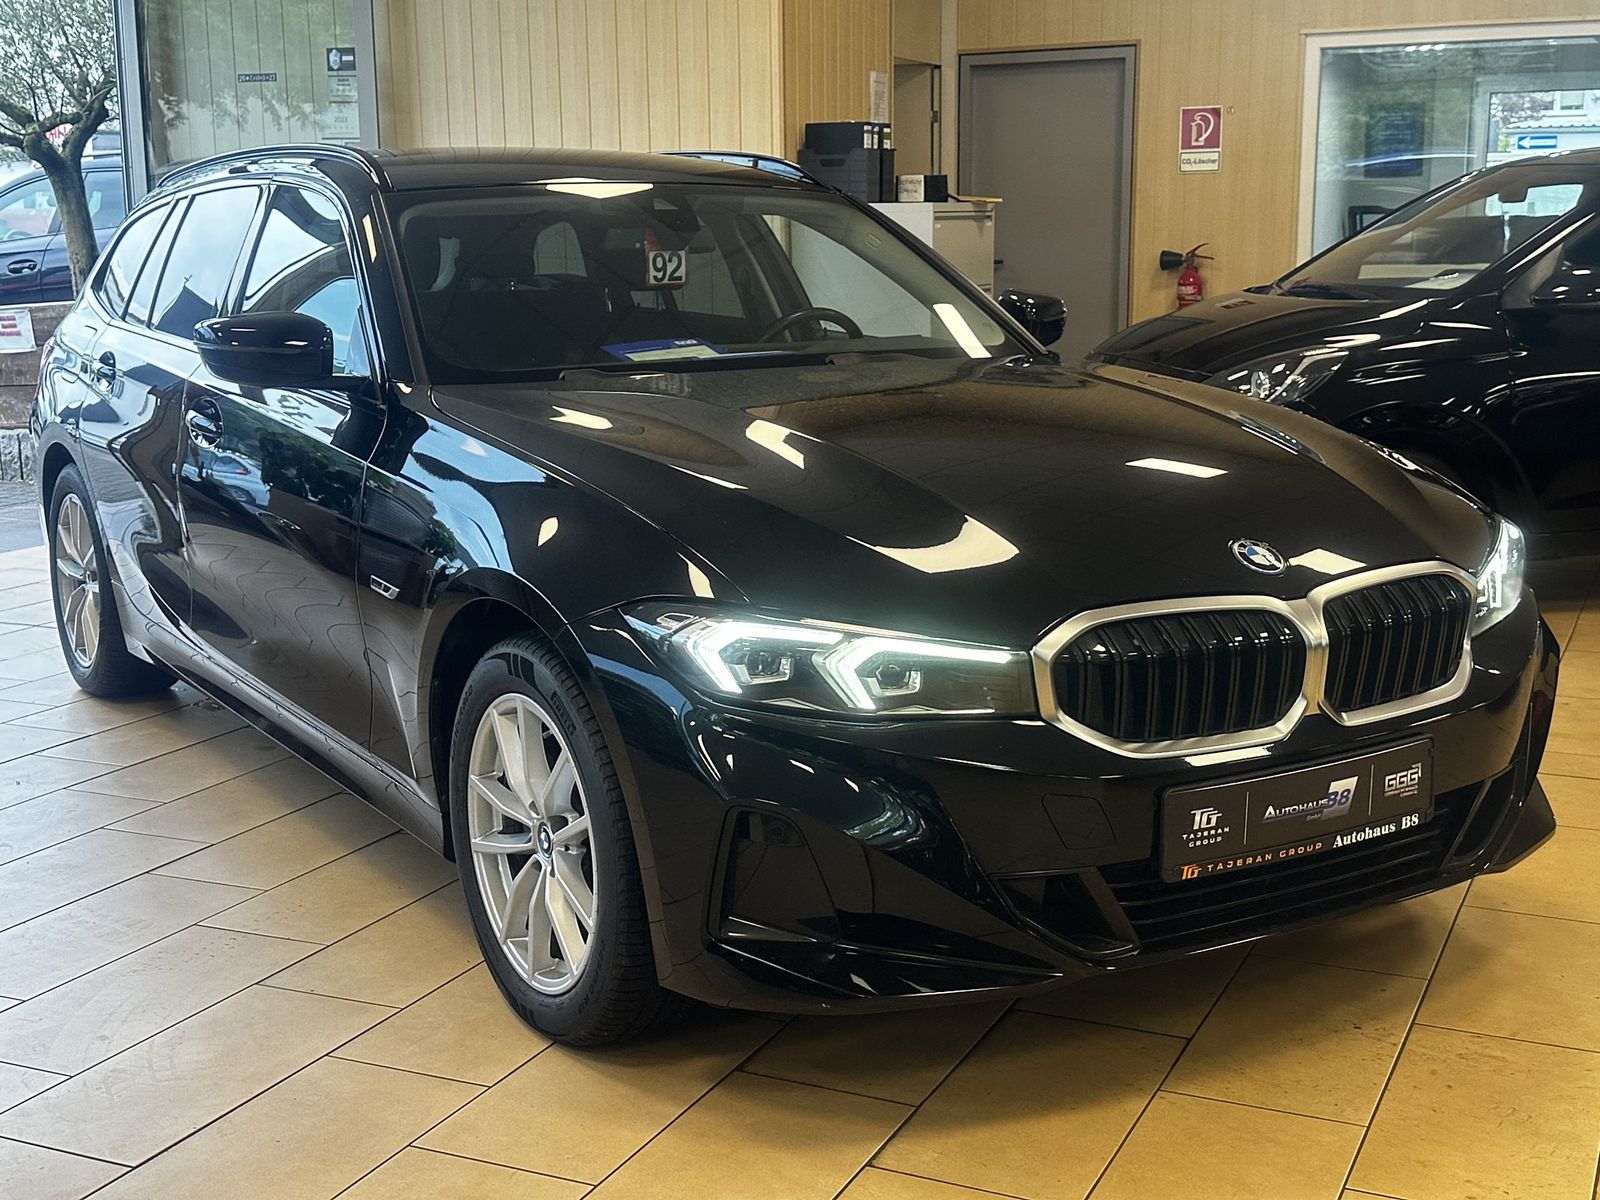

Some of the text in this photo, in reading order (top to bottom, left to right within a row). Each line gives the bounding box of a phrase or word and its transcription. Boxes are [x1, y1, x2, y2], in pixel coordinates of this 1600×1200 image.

[651, 252, 683, 282] 92
[1326, 788, 1351, 809] B8
[1181, 826, 1230, 840] TAJERAN
[1188, 836, 1222, 848] GROUP
[1207, 852, 1273, 872] TAJERAN
[1279, 842, 1323, 858] GROUP
[1332, 822, 1396, 848] Autohaus
[1401, 813, 1420, 830] B8
